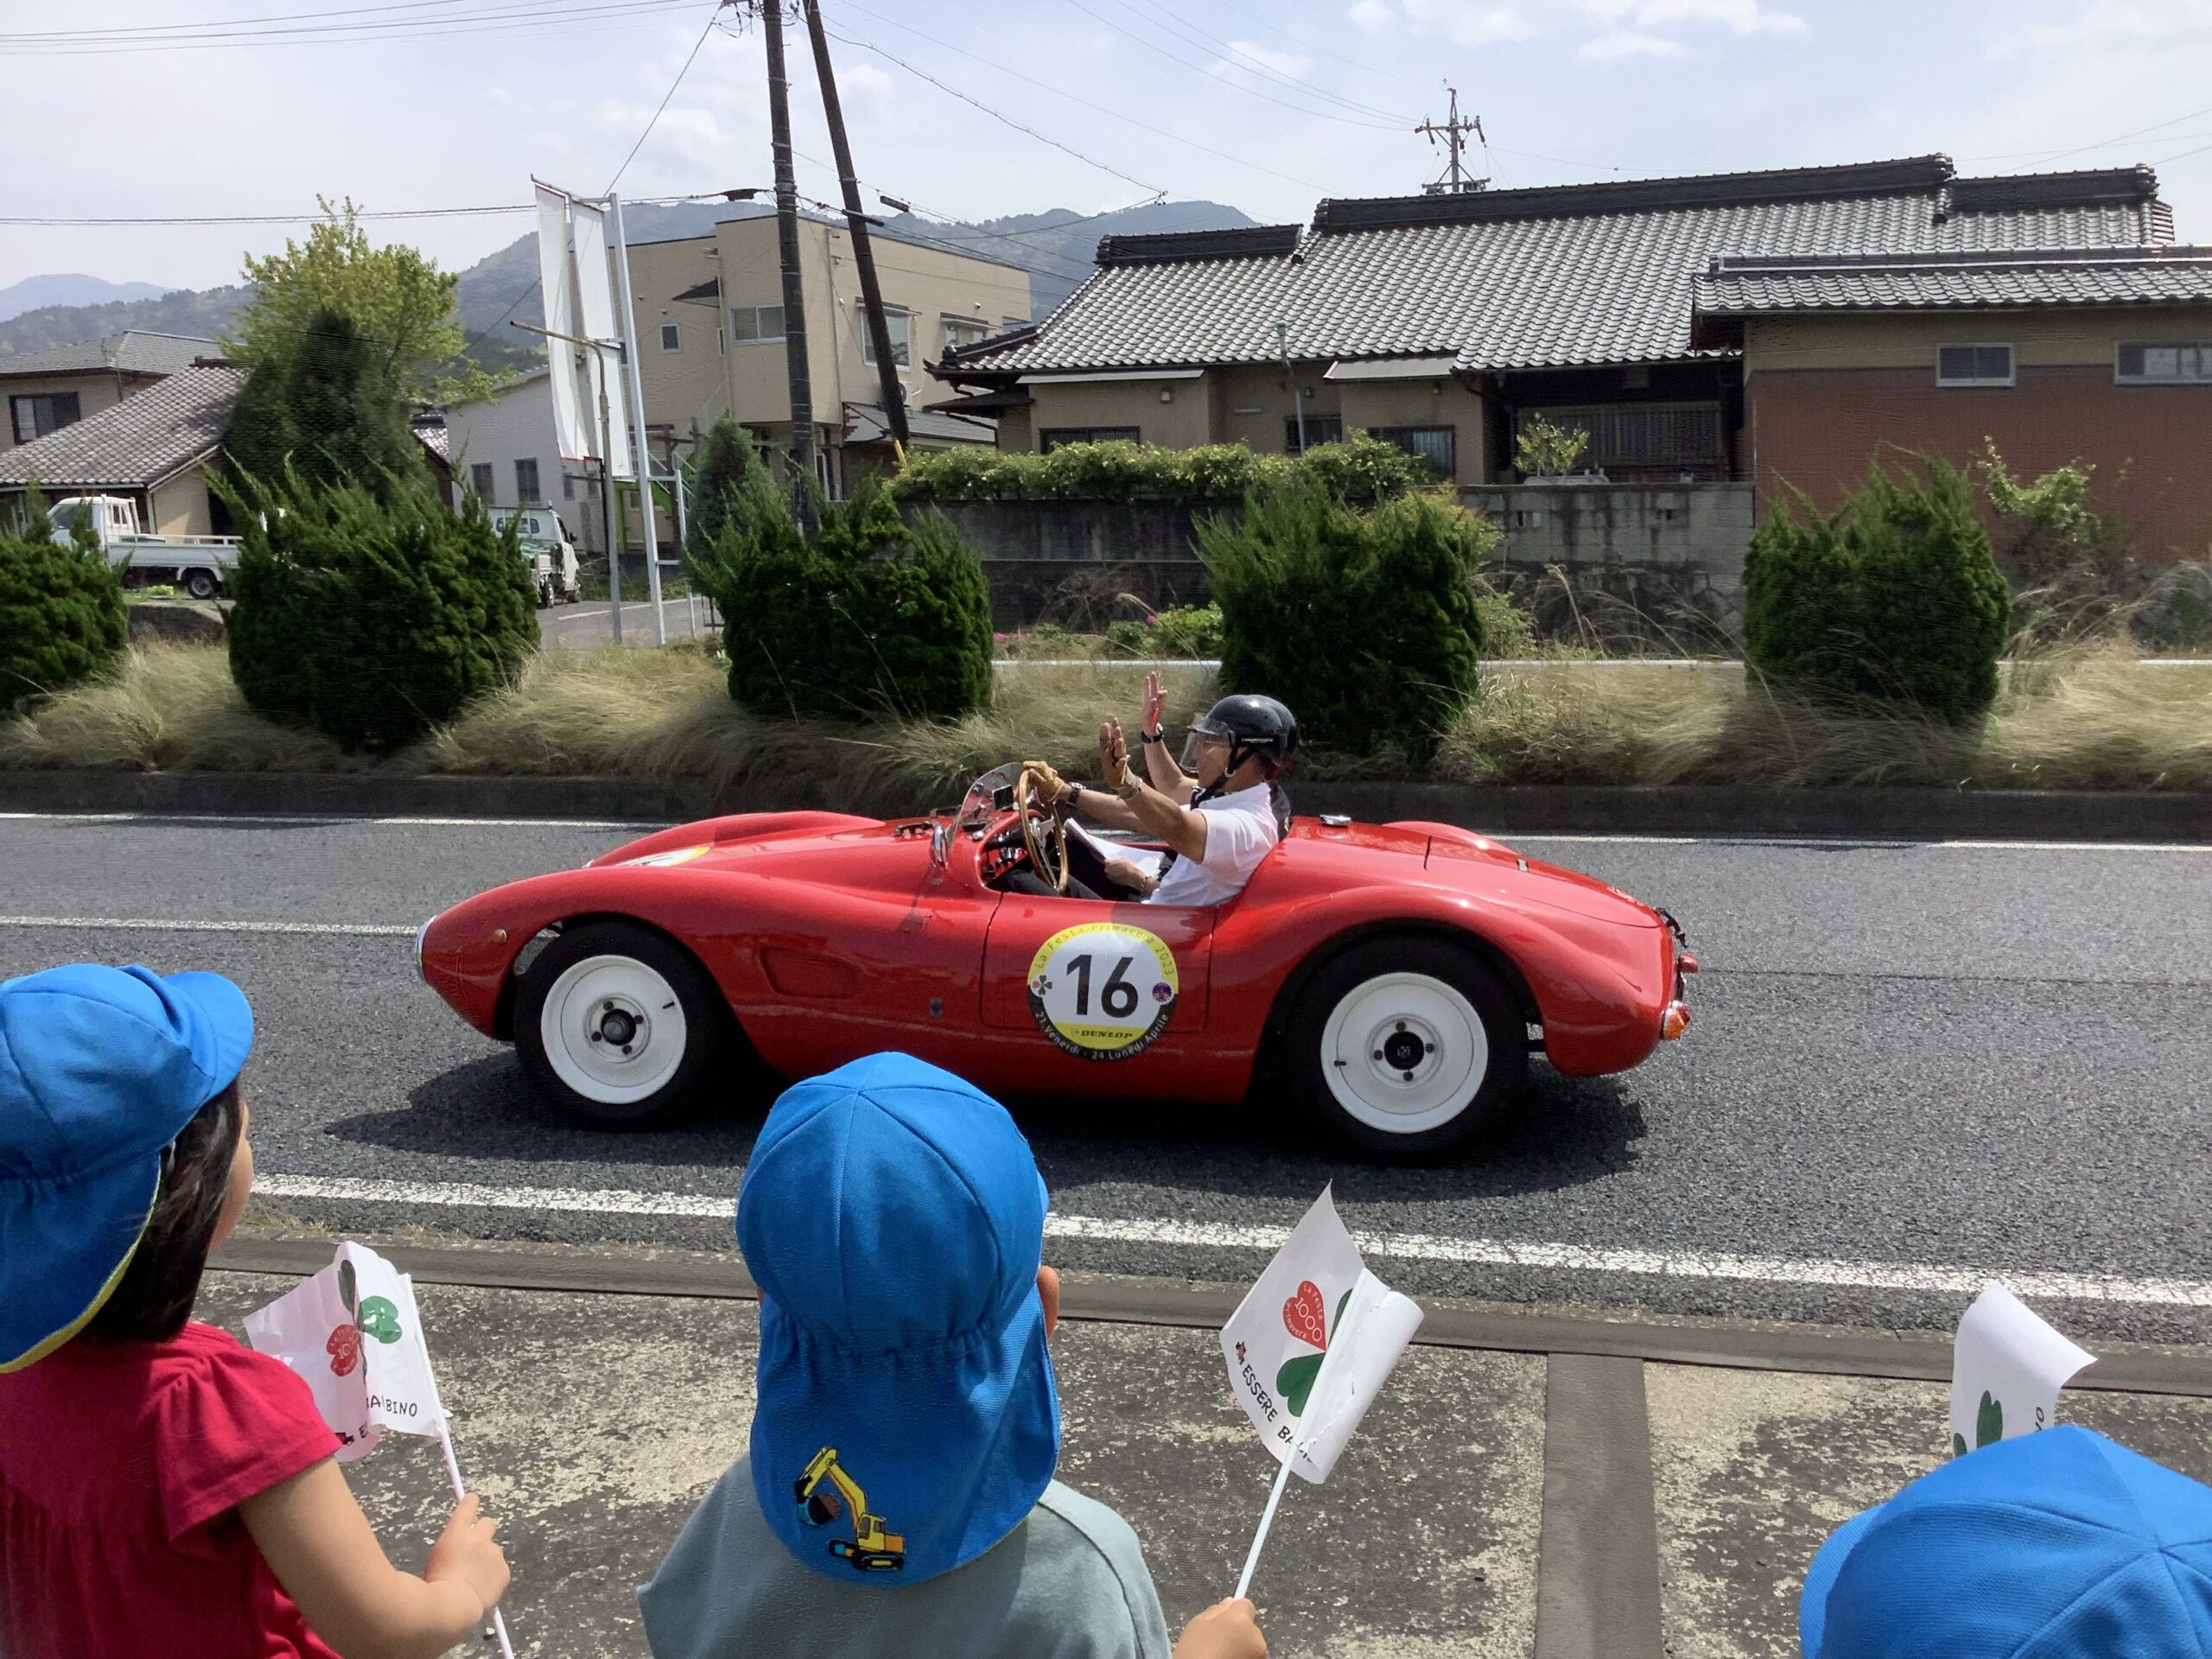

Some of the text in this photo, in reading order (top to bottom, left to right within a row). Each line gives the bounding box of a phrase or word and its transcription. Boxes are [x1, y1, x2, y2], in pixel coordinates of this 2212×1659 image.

[1034, 954, 1047, 969] La
[1046, 927, 1084, 950] Festa
[1155, 946, 1174, 976] 2023
[1065, 954, 1139, 1018] 16
[1080, 1029, 1134, 1039] DUNLOP
[1144, 1014, 1169, 1043] Aprile
[1284, 1301, 1307, 1340] Primavera
[1294, 1297, 1323, 1343] 1000
[1312, 1291, 1324, 1321] Festa
[1242, 1363, 1278, 1422] ESSERE
